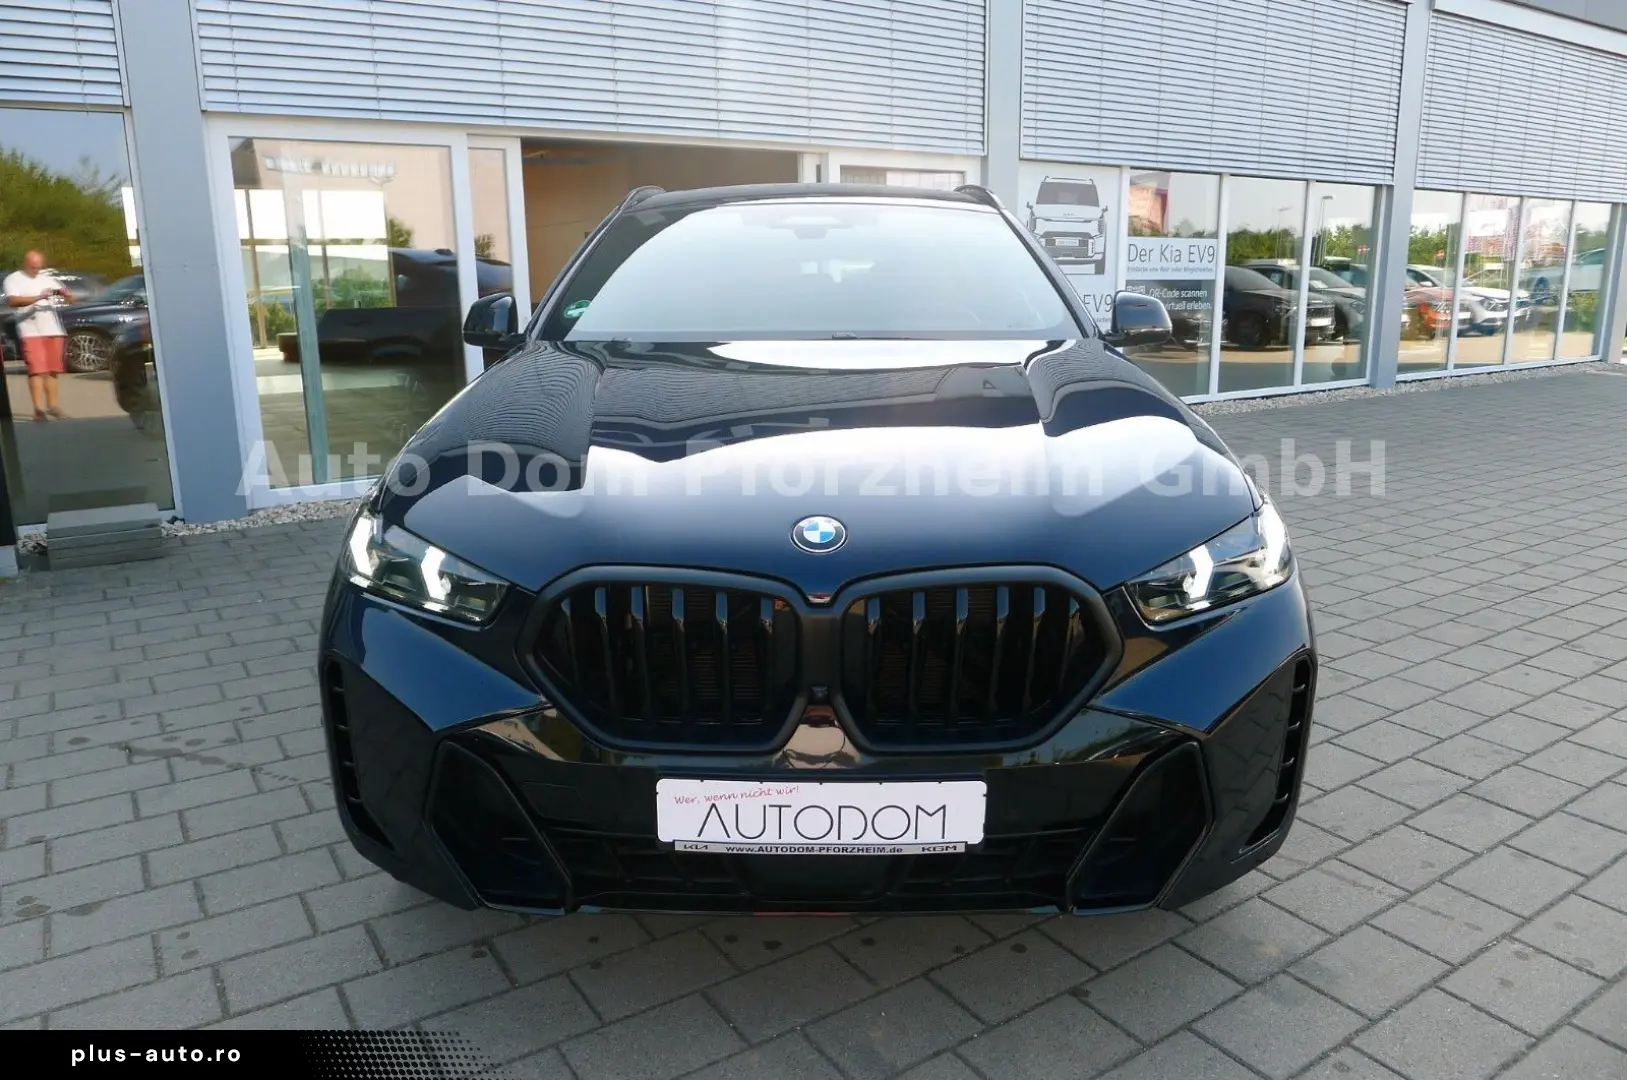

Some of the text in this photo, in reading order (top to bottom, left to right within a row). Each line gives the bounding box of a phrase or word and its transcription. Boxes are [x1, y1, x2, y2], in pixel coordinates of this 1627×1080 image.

[1127, 243, 1215, 264] Der Kia EV9
[1180, 290, 1208, 298] scannen
[674, 785, 799, 805] Wer, wenn nicht wir!
[697, 802, 947, 841] AUTODOM
[725, 845, 903, 854] www.AUTODOM-PFORZHEIM.de
